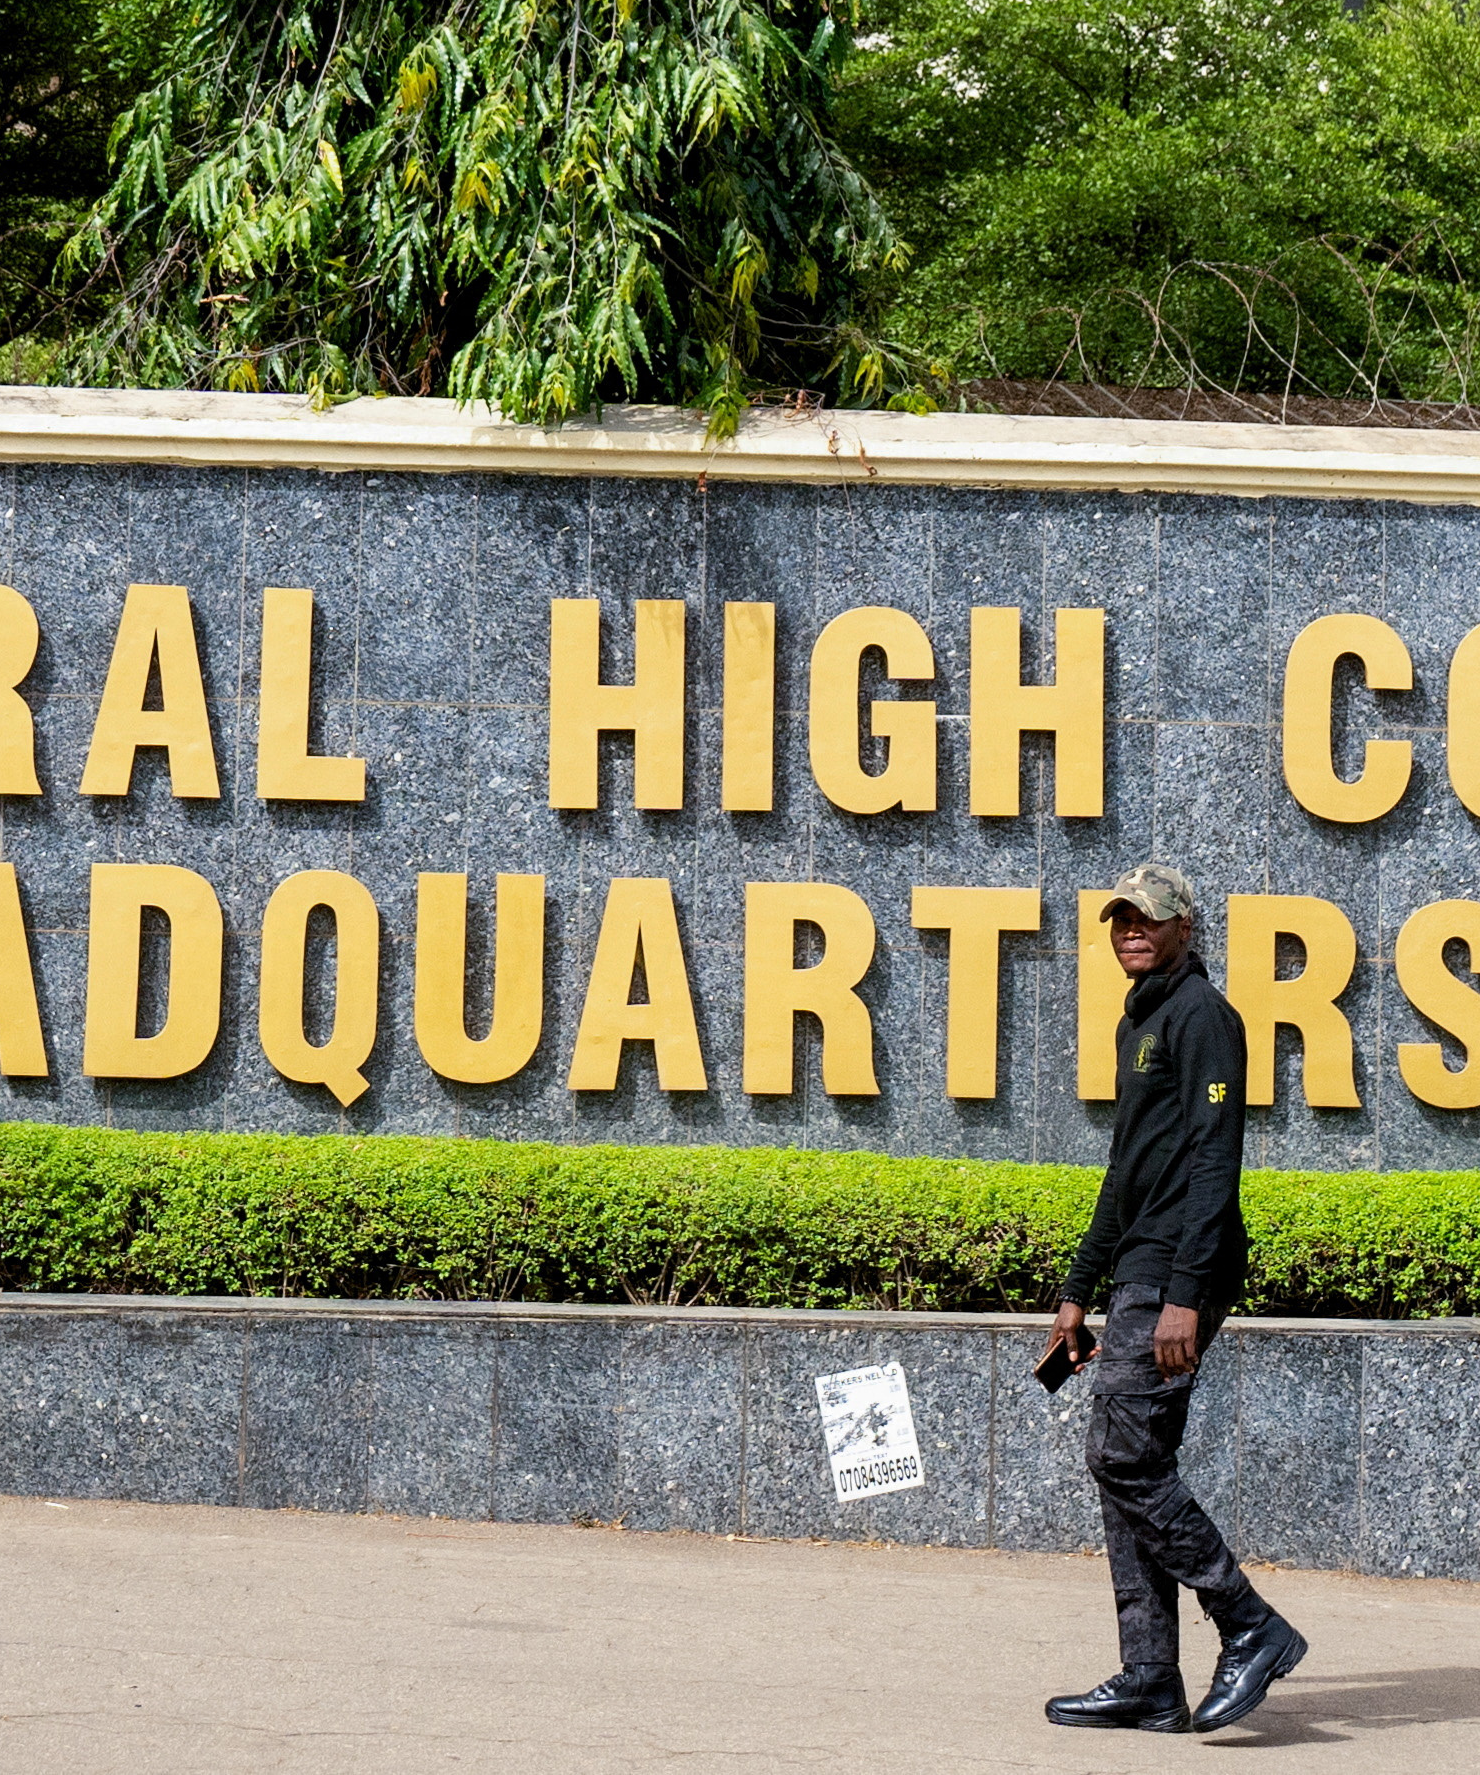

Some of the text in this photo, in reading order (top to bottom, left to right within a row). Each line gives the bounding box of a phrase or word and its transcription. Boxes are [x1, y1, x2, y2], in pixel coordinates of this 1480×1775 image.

[548, 598, 1106, 818] HIGH
[1207, 1082, 1227, 1104] SF
[838, 1454, 919, 1493] 07084396569
